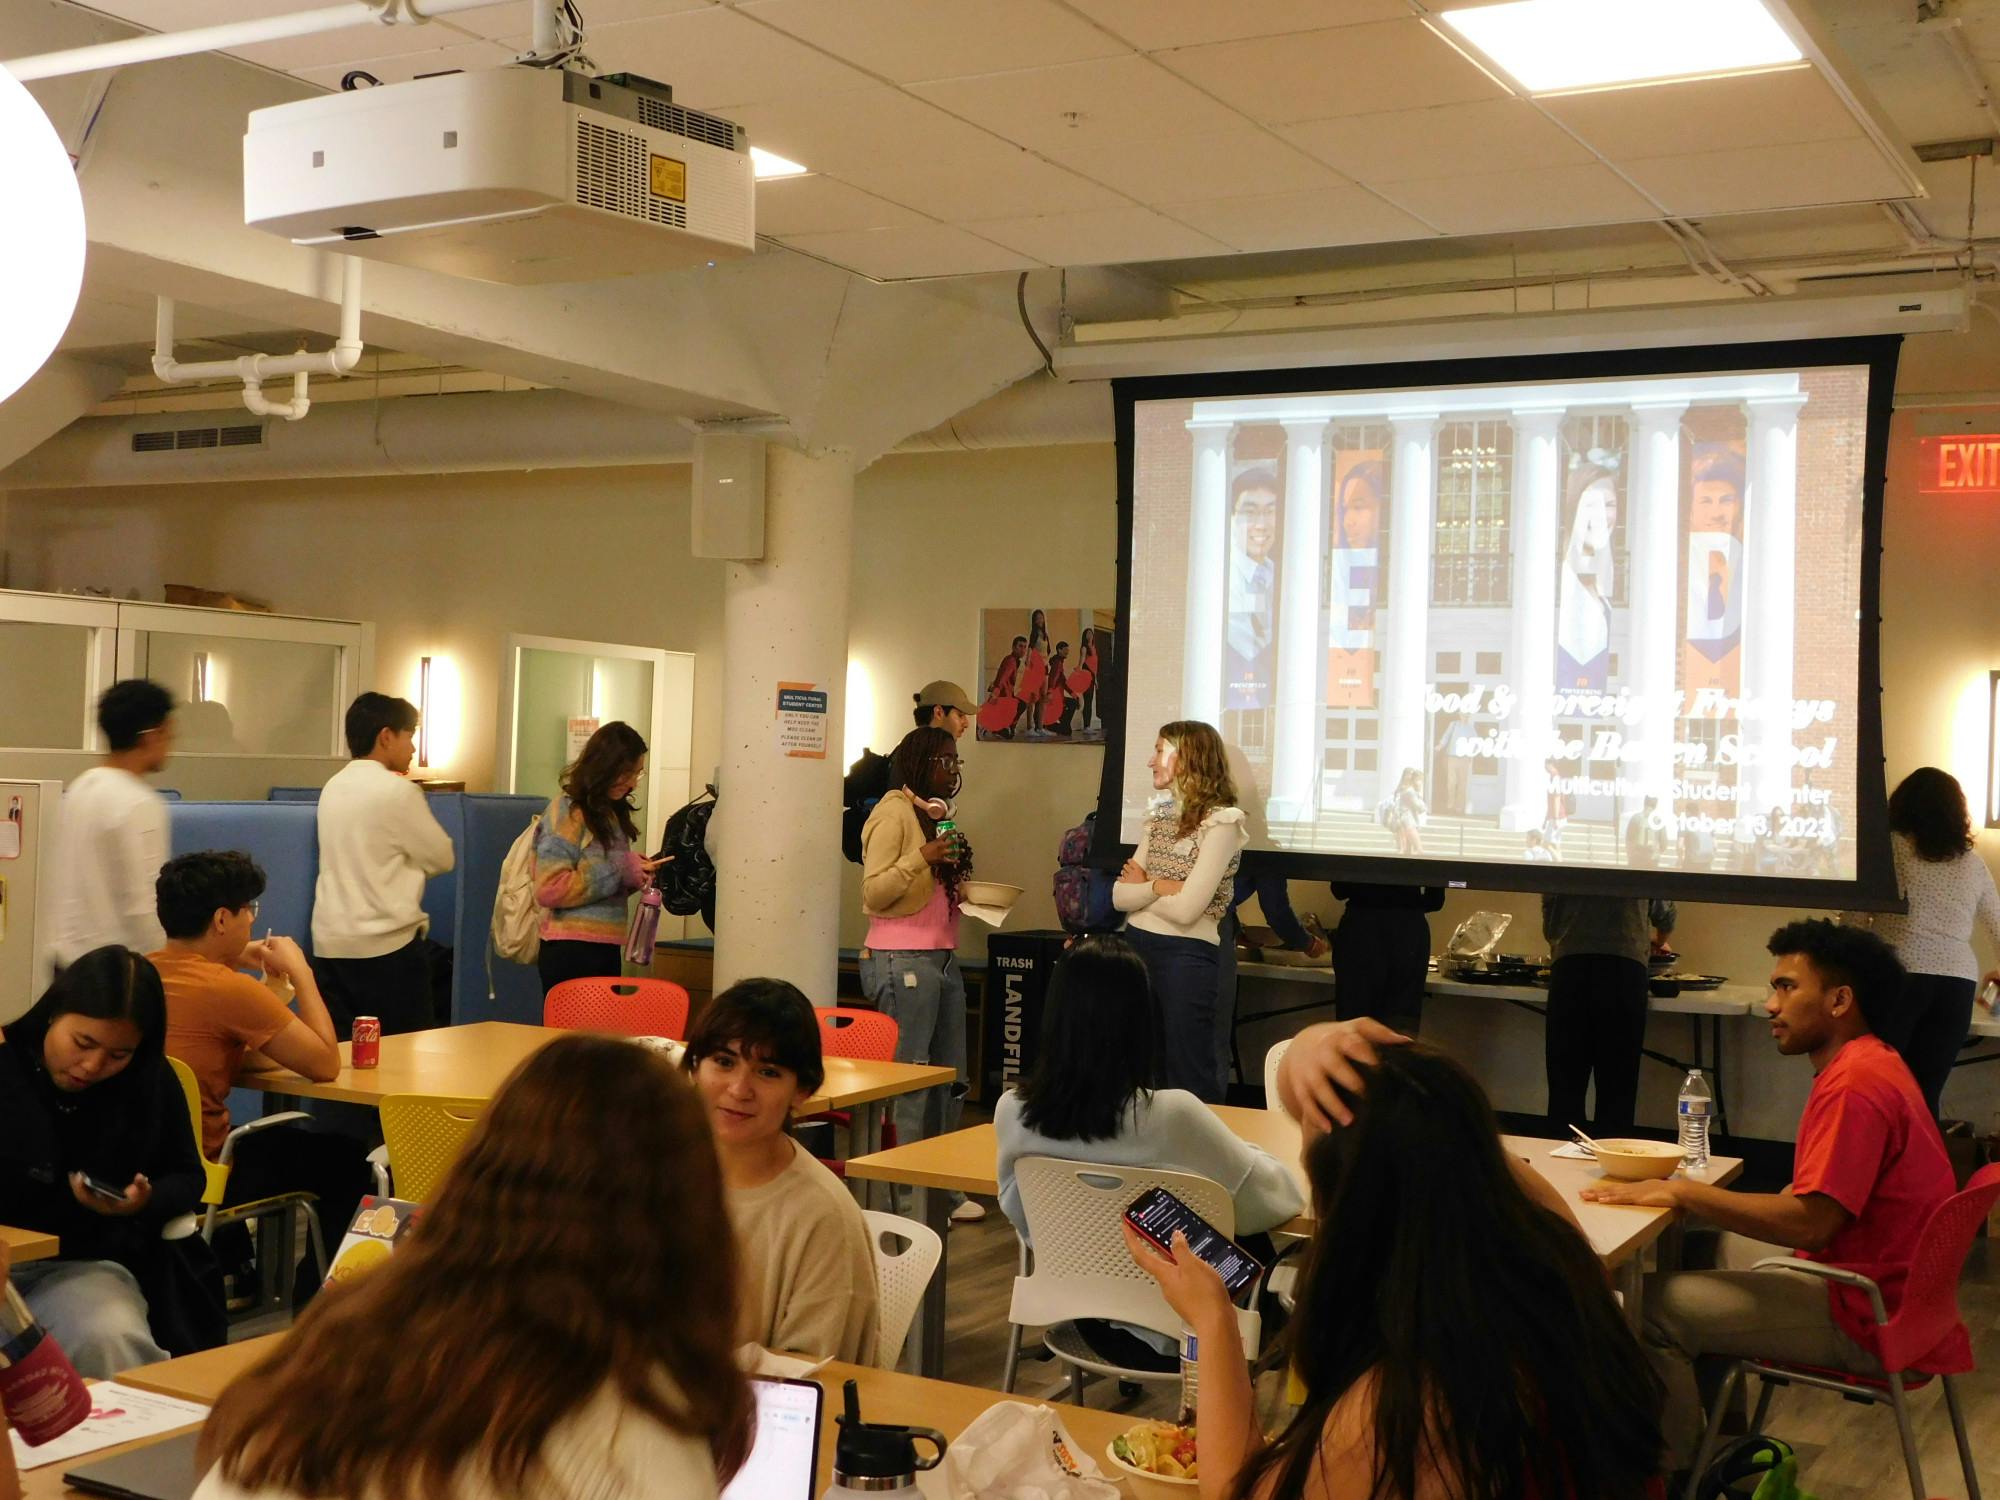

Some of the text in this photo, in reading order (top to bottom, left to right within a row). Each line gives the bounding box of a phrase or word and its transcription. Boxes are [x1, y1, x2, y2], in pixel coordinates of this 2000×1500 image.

[1939, 443, 2000, 487] EXIT
[1412, 684, 1486, 714] ood
[996, 956, 1034, 969] TRASH
